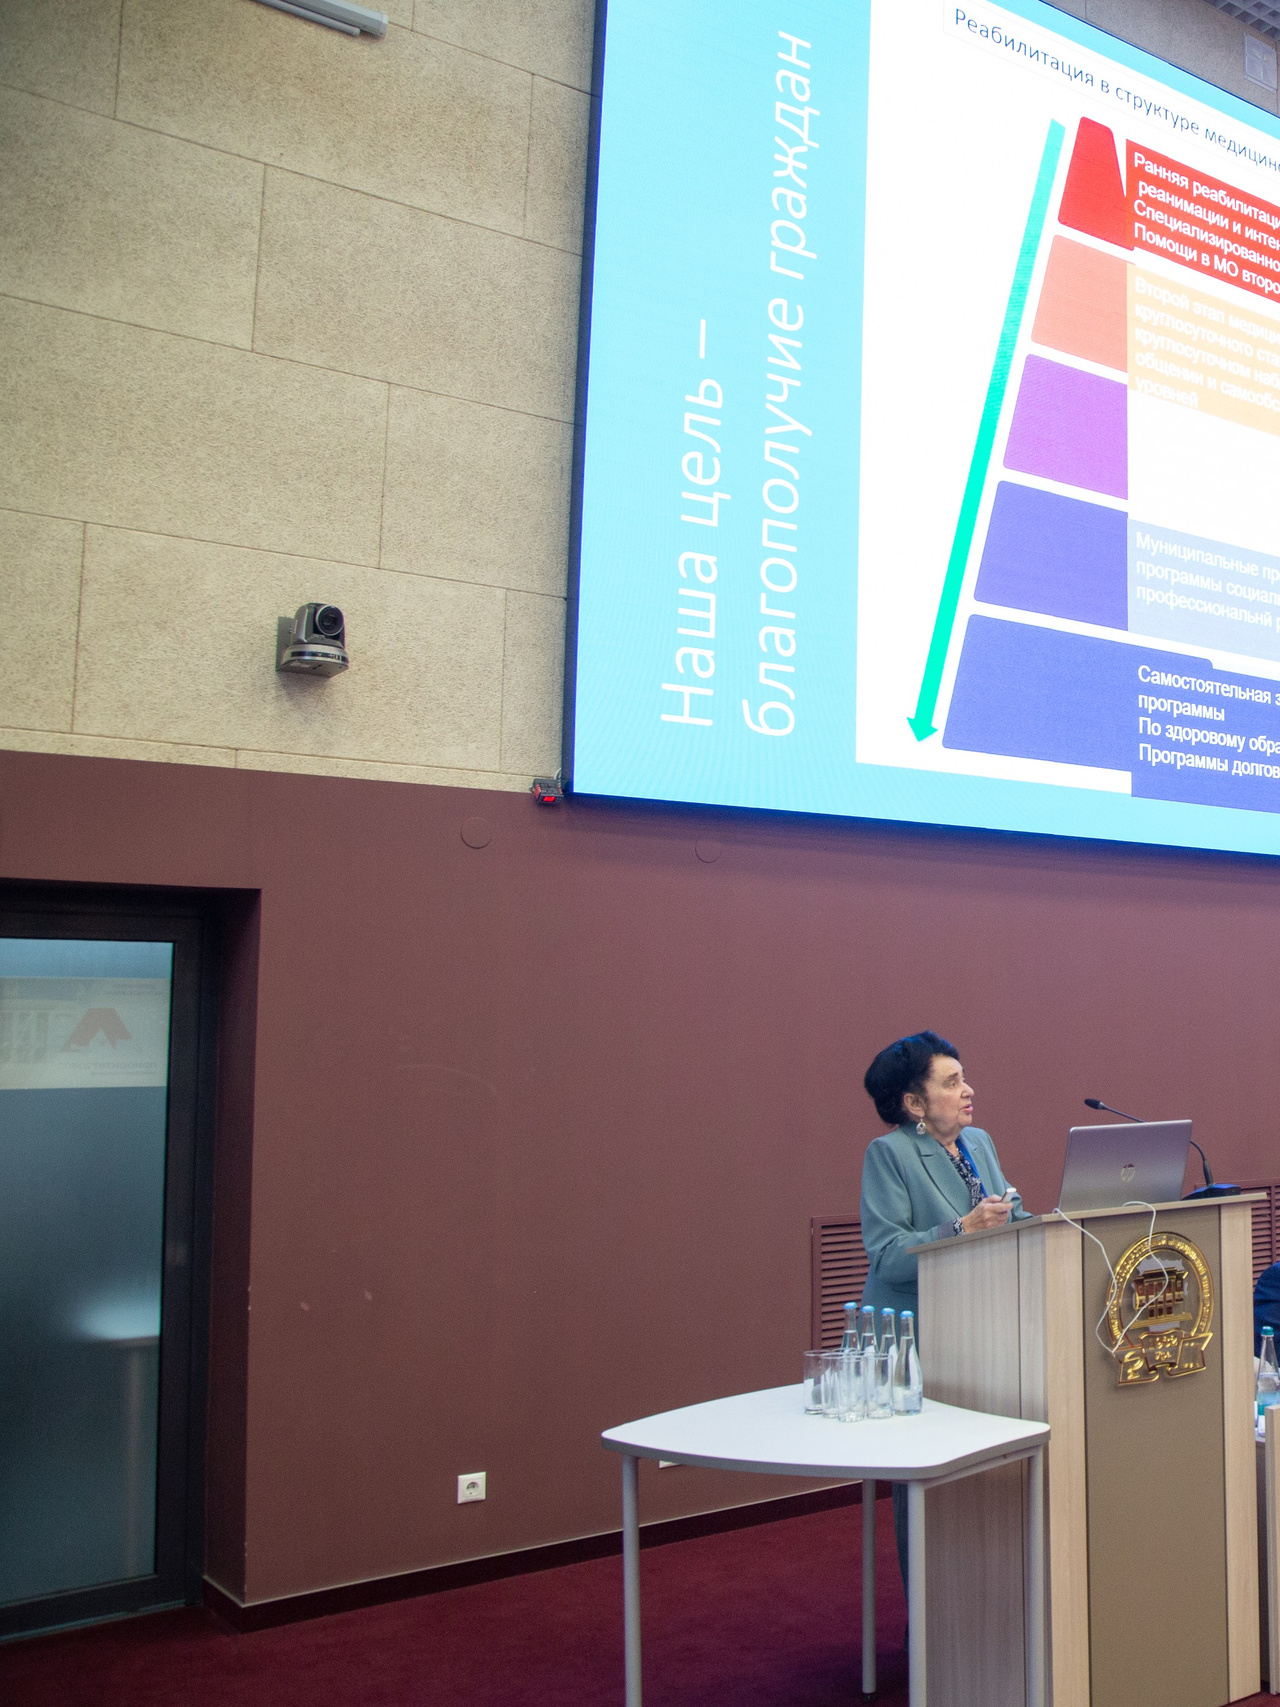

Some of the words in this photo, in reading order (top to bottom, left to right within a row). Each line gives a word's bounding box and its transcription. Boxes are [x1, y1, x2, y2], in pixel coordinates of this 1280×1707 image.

[955, 7, 1094, 87] Реабилитация
[1100, 79, 1110, 93] в
[1115, 86, 1199, 135] структуре
[770, 30, 820, 280] граждан
[1134, 151, 1189, 189] Ранняя
[1138, 180, 1229, 230] реанимации
[1232, 220, 1241, 235] и
[1134, 221, 1197, 262] Помощи
[1200, 252, 1210, 266] в
[1213, 254, 1239, 277] МО
[1134, 375, 1199, 408] уровней
[681, 378, 731, 527] цель
[742, 297, 812, 737] благополучие
[1136, 531, 1259, 576] Муниципальные
[1135, 560, 1222, 592] программы
[1136, 585, 1272, 627] профессиональнй
[661, 552, 718, 727] Наша
[1137, 664, 1271, 704] Самостоятельная
[1138, 694, 1225, 721] программы
[1138, 716, 1161, 736] По
[1164, 724, 1246, 753] здоровому
[1138, 742, 1228, 772] Программы
